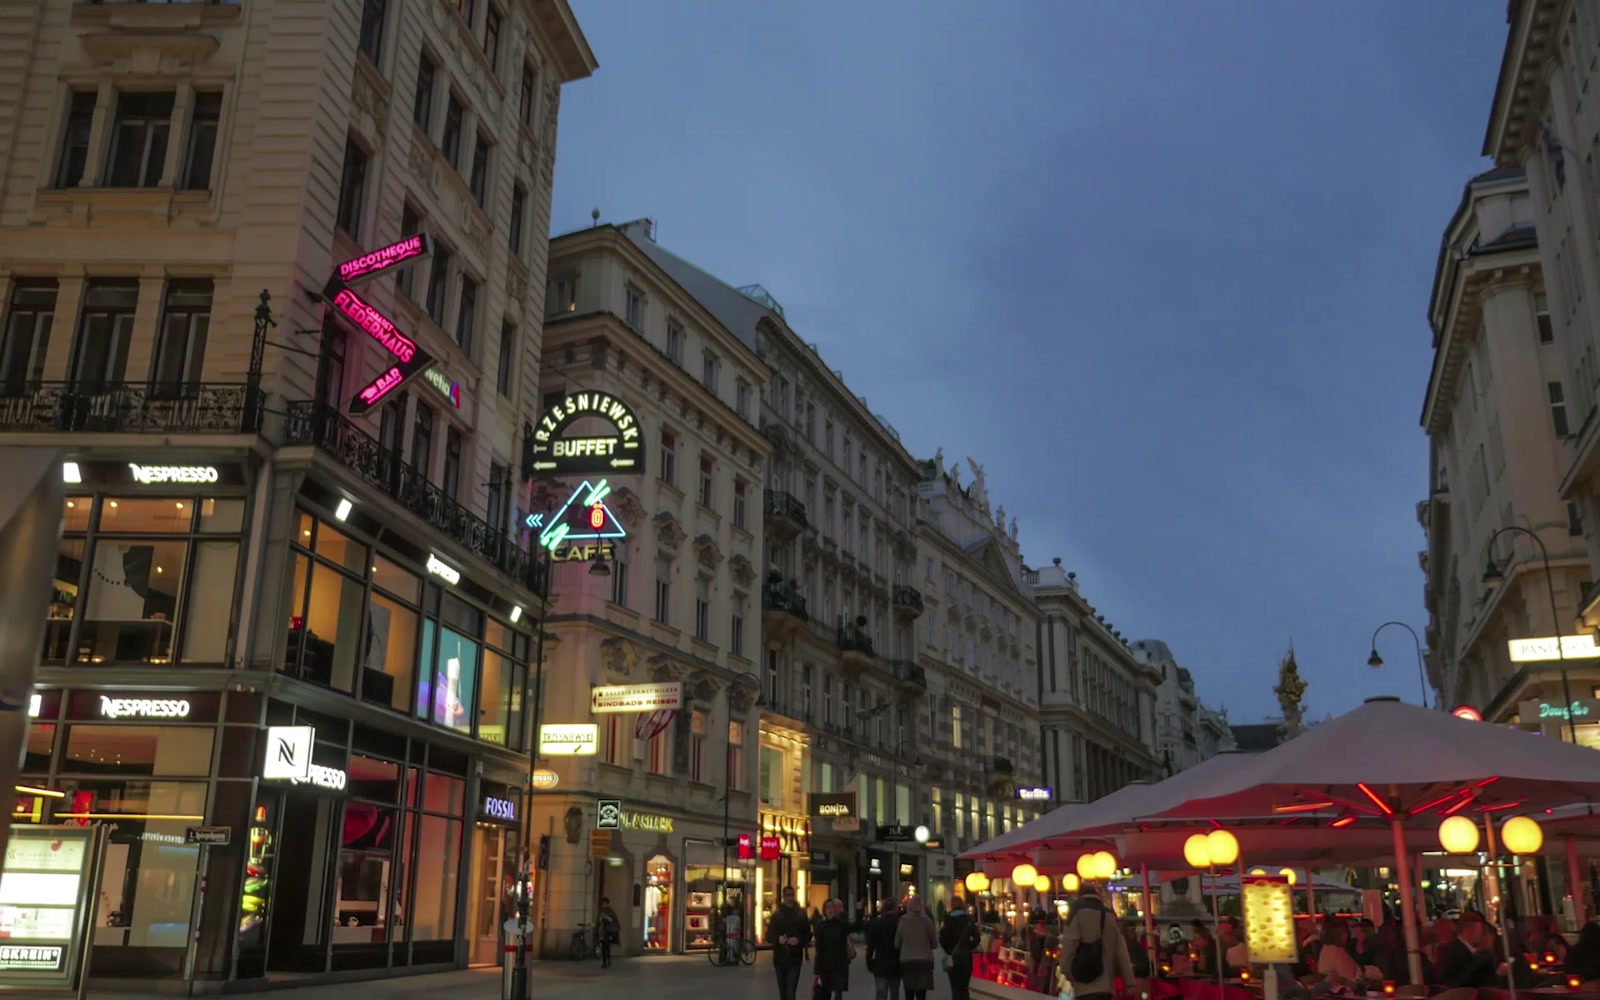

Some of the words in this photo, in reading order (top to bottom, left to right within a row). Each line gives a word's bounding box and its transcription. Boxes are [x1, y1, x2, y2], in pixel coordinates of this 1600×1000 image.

[340, 236, 421, 276] DISCOTHEQUE
[334, 292, 414, 364] FLEDERMAUS
[365, 306, 394, 331] CABARET
[376, 366, 401, 391] BAR
[553, 438, 618, 457] BUFFET
[532, 774, 553, 782] OSSIL
[485, 796, 515, 820] FOSSIL
